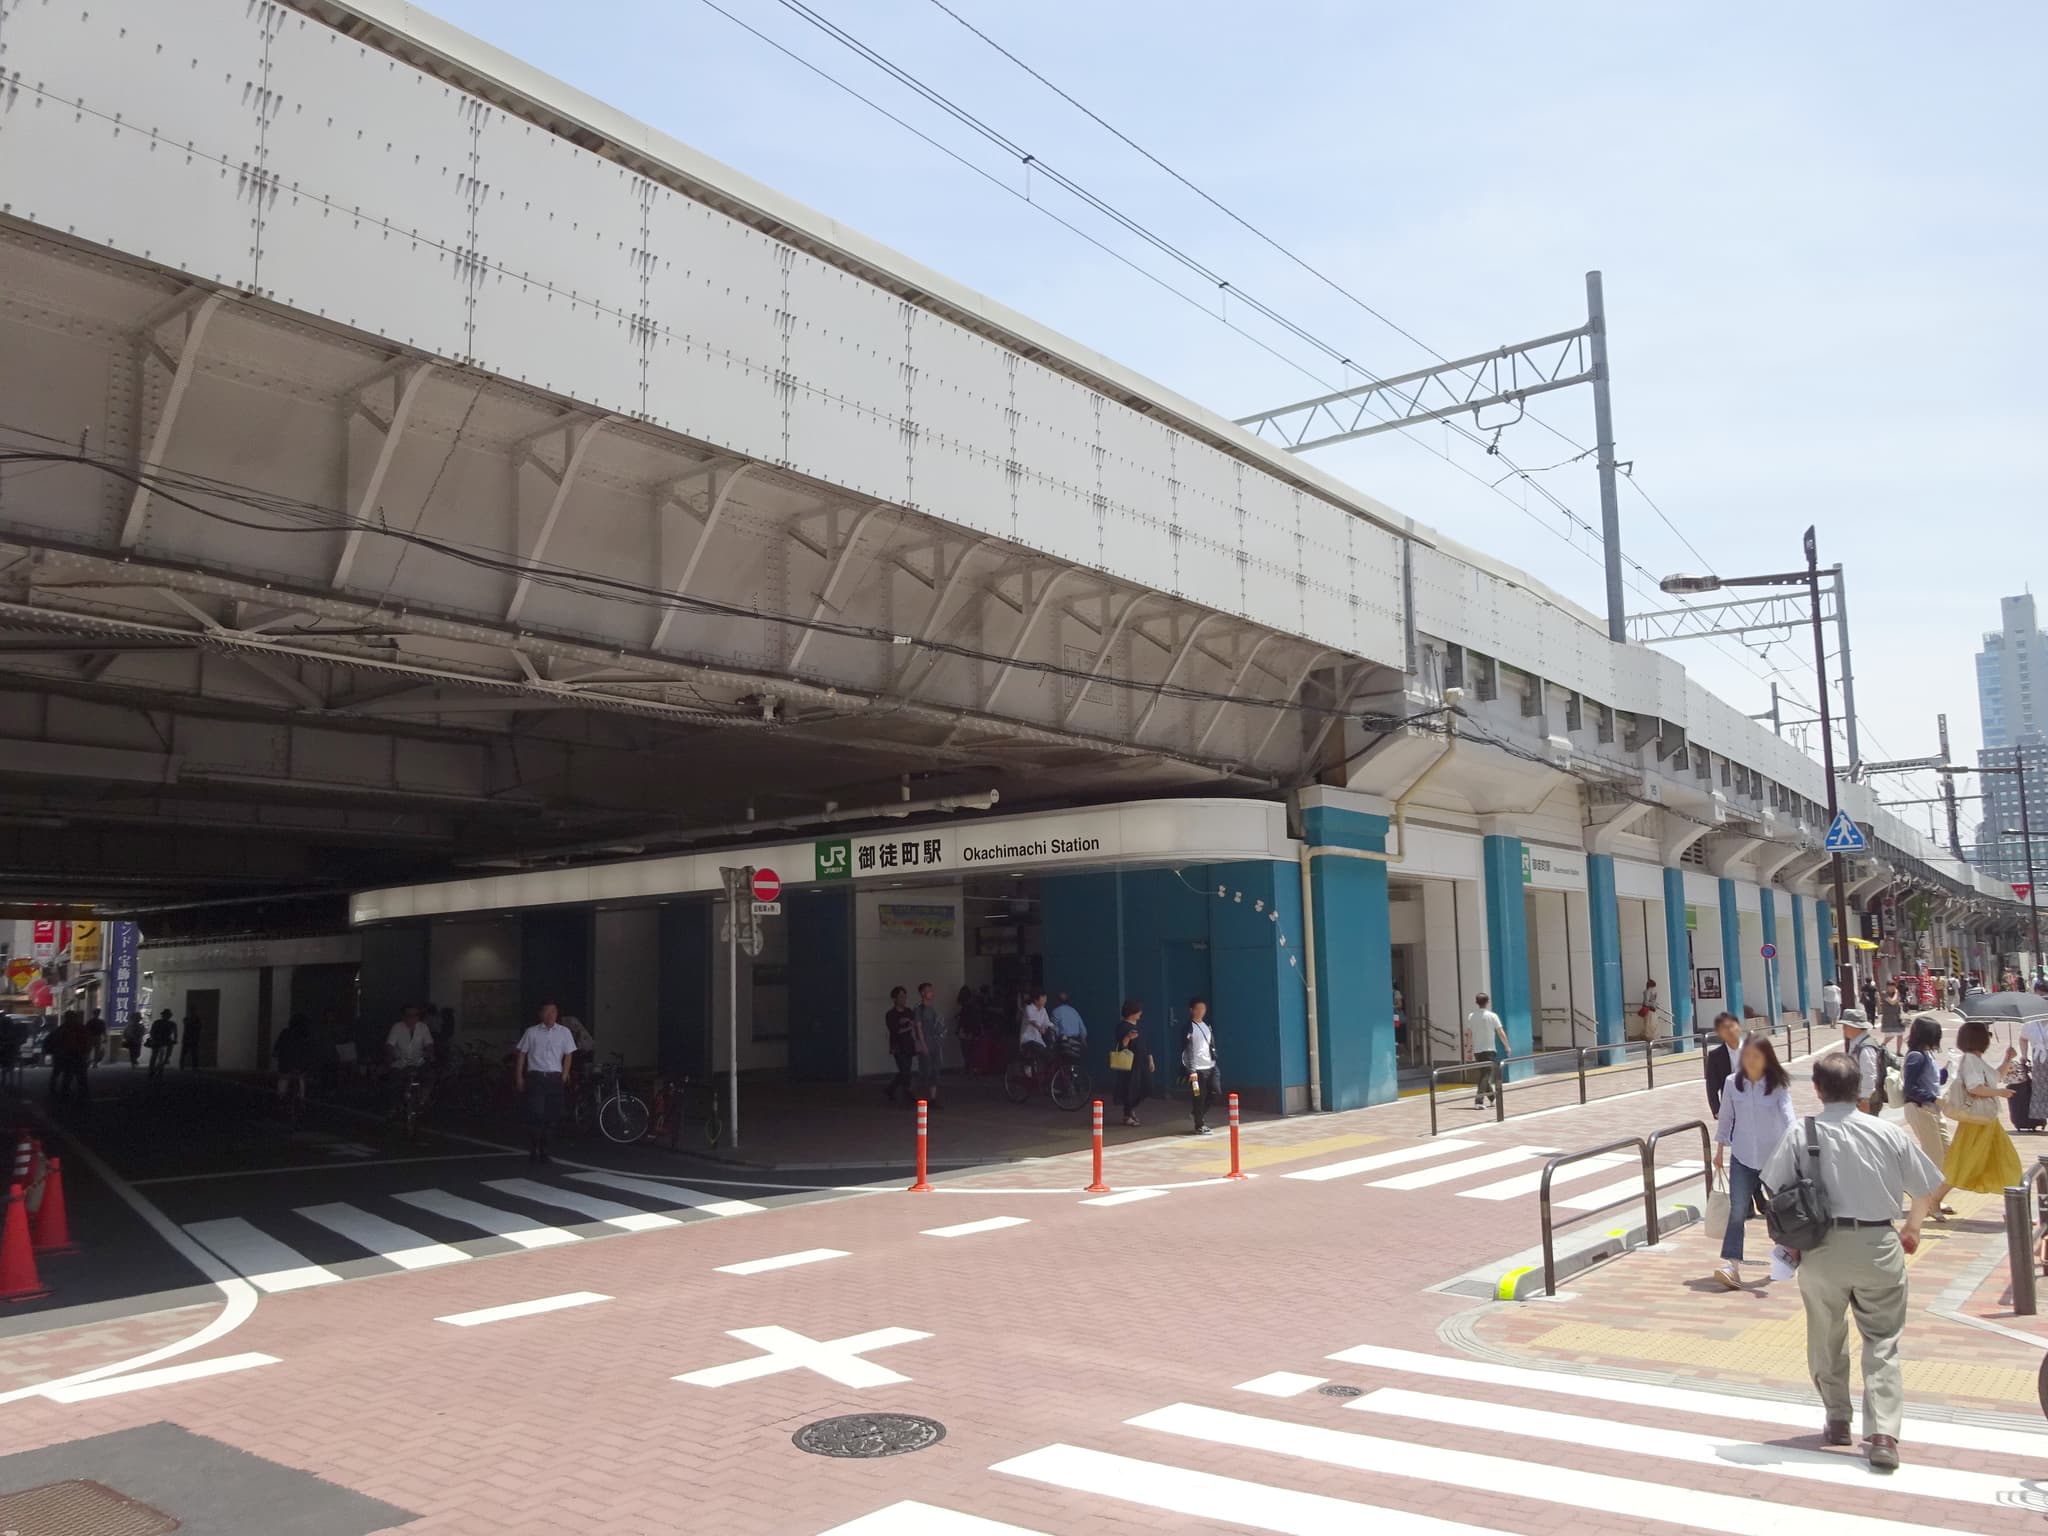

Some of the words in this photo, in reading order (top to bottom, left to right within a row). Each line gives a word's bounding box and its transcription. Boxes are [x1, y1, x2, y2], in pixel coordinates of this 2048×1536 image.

[820, 846, 847, 867] JR
[858, 839, 941, 870] 御徒町駅
[963, 841, 1047, 861] Okachimachi
[1051, 838, 1099, 854] Station
